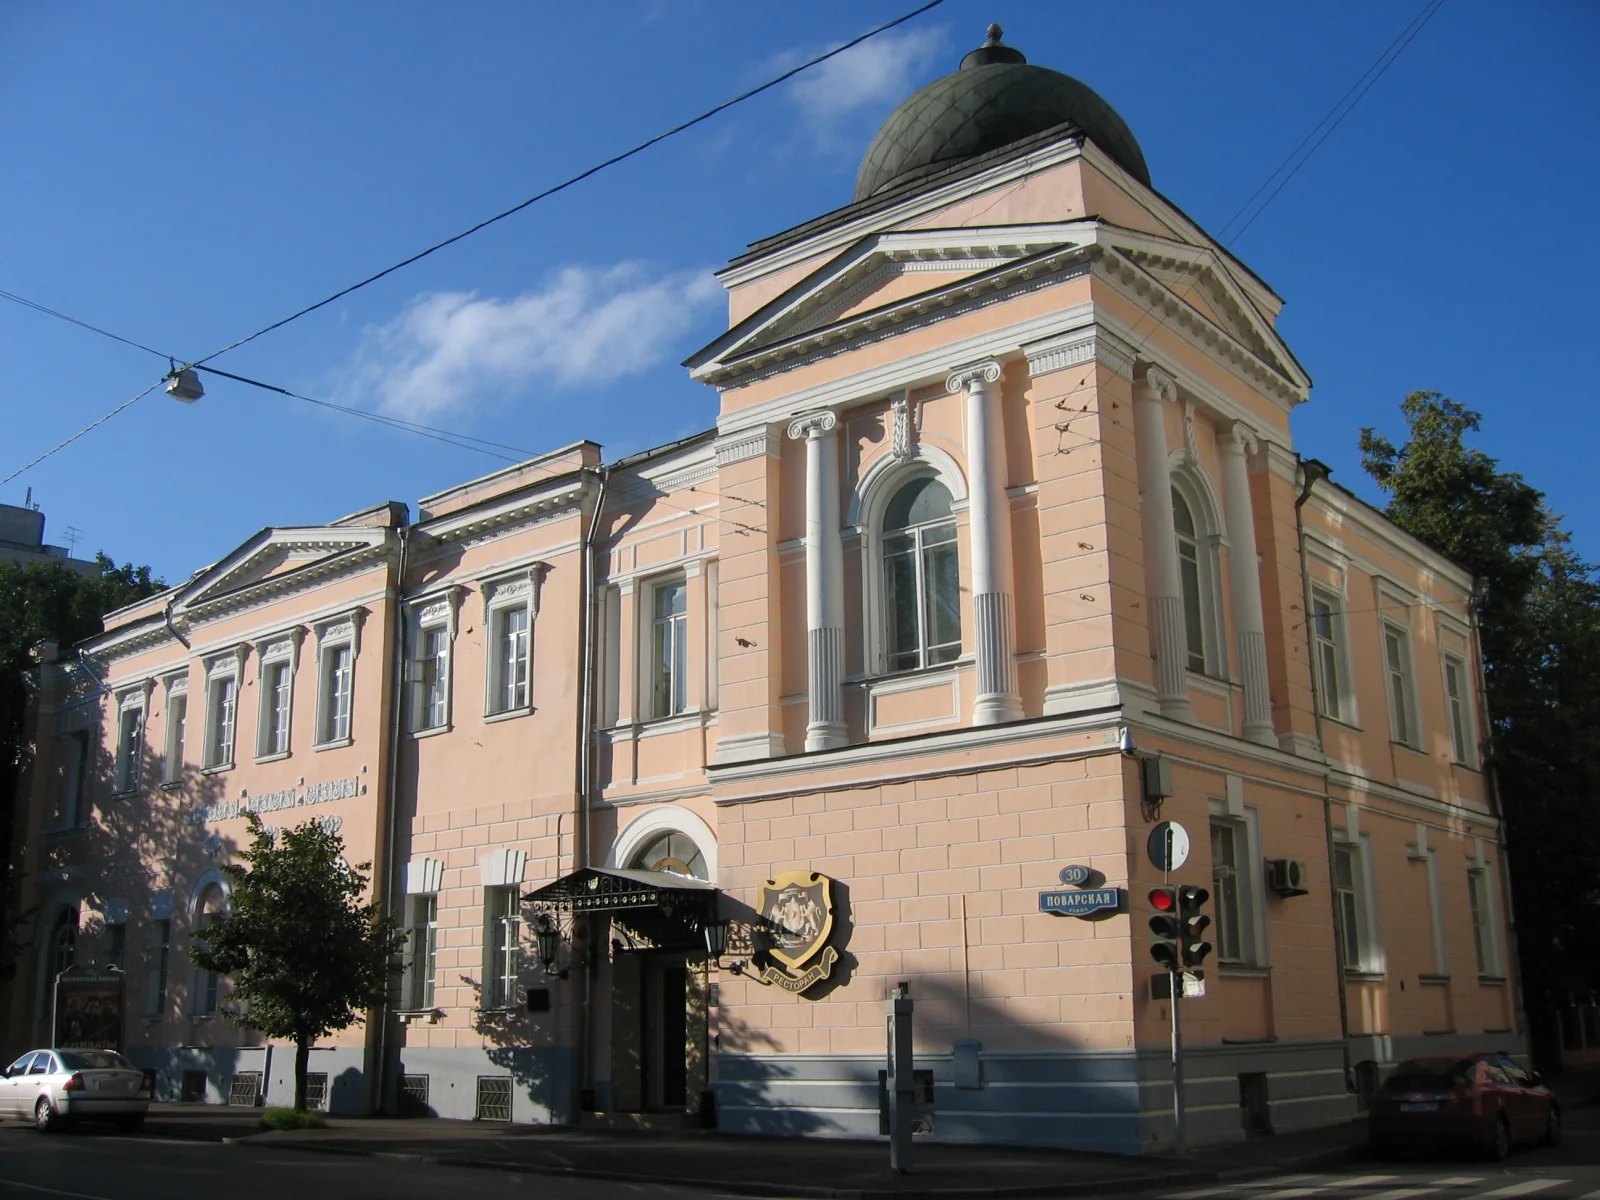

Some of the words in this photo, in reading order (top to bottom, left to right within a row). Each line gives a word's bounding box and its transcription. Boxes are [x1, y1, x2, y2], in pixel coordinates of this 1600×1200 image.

[1066, 868, 1081, 881] 30
[1046, 893, 1110, 906] ПОВАРСКАЯ
[773, 972, 815, 990] РЕСТОРАН
